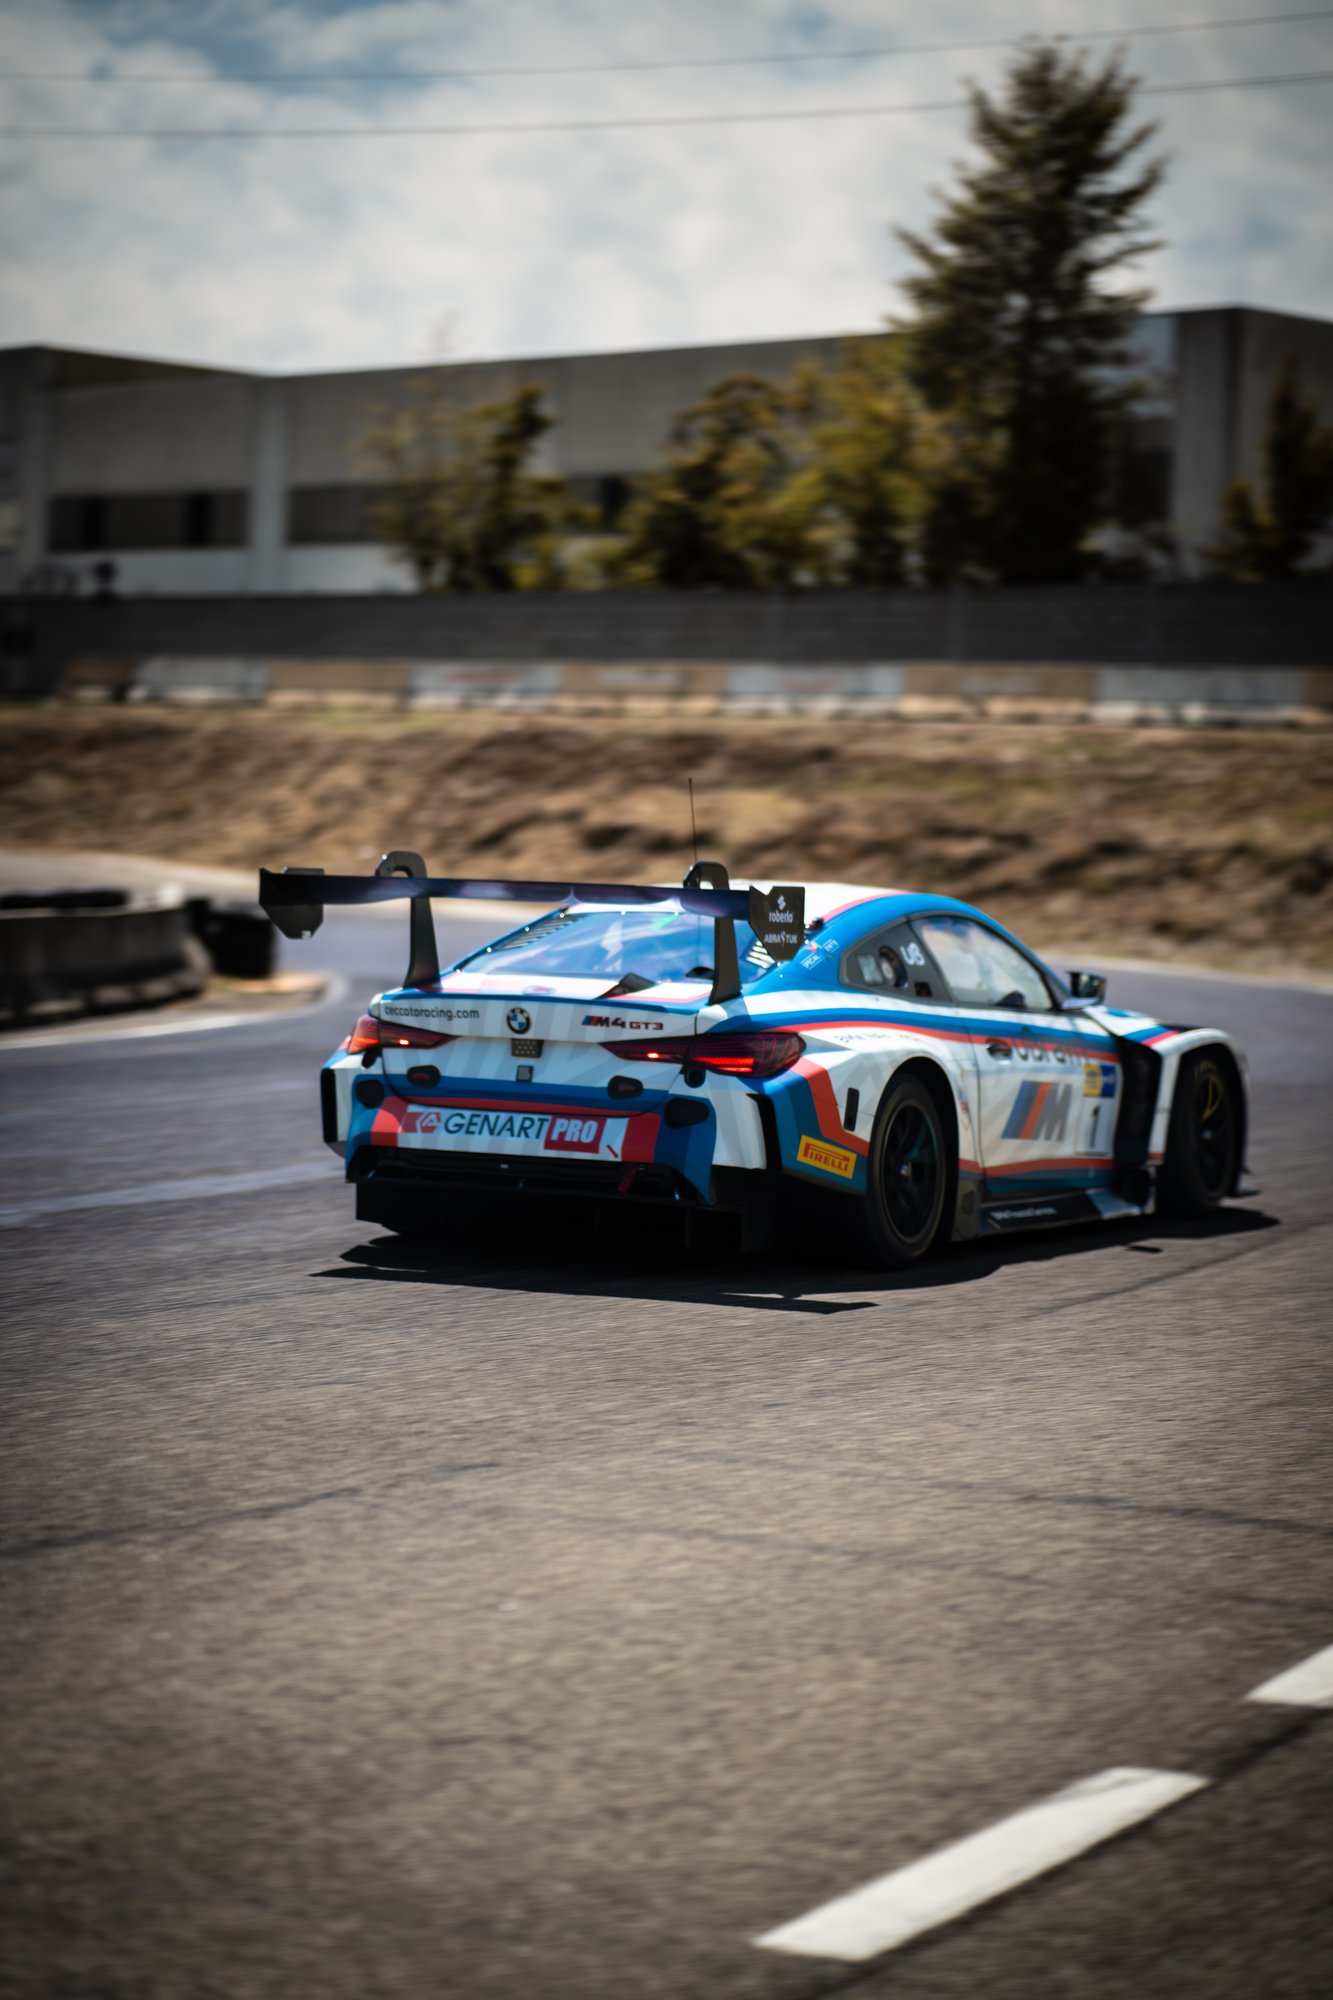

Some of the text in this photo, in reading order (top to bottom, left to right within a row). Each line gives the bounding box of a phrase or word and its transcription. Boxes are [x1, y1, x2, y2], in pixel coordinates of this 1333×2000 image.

[589, 1015, 664, 1031] M4 GT3
[444, 1112, 549, 1140] GENART
[550, 1117, 599, 1143] PRO
[1089, 1105, 1102, 1149] 1
[802, 1141, 851, 1172] PIRELLI
